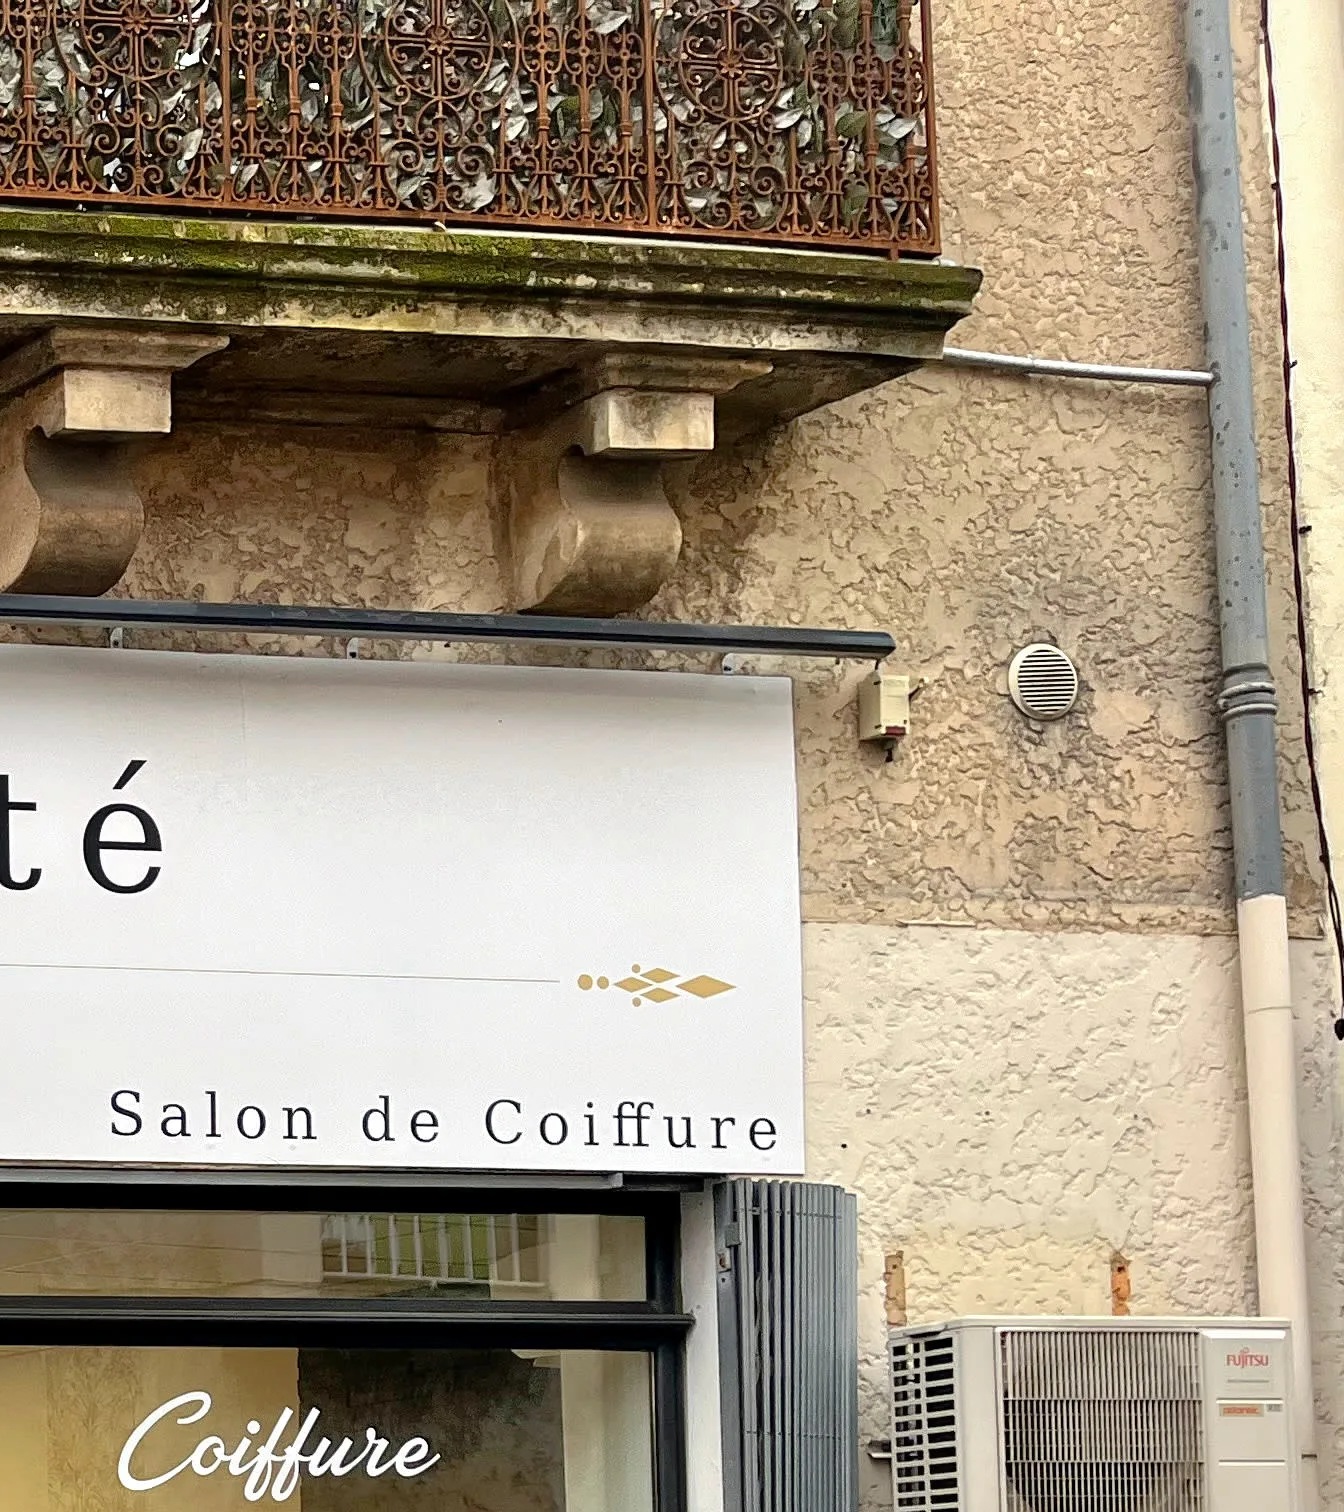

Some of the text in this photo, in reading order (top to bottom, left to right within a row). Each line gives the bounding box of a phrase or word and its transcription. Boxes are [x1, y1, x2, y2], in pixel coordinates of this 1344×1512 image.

[110, 1089, 780, 1153] Salon de Coiffure
[1226, 1347, 1269, 1368] FUJITSU
[117, 1391, 441, 1502] Coiffure
